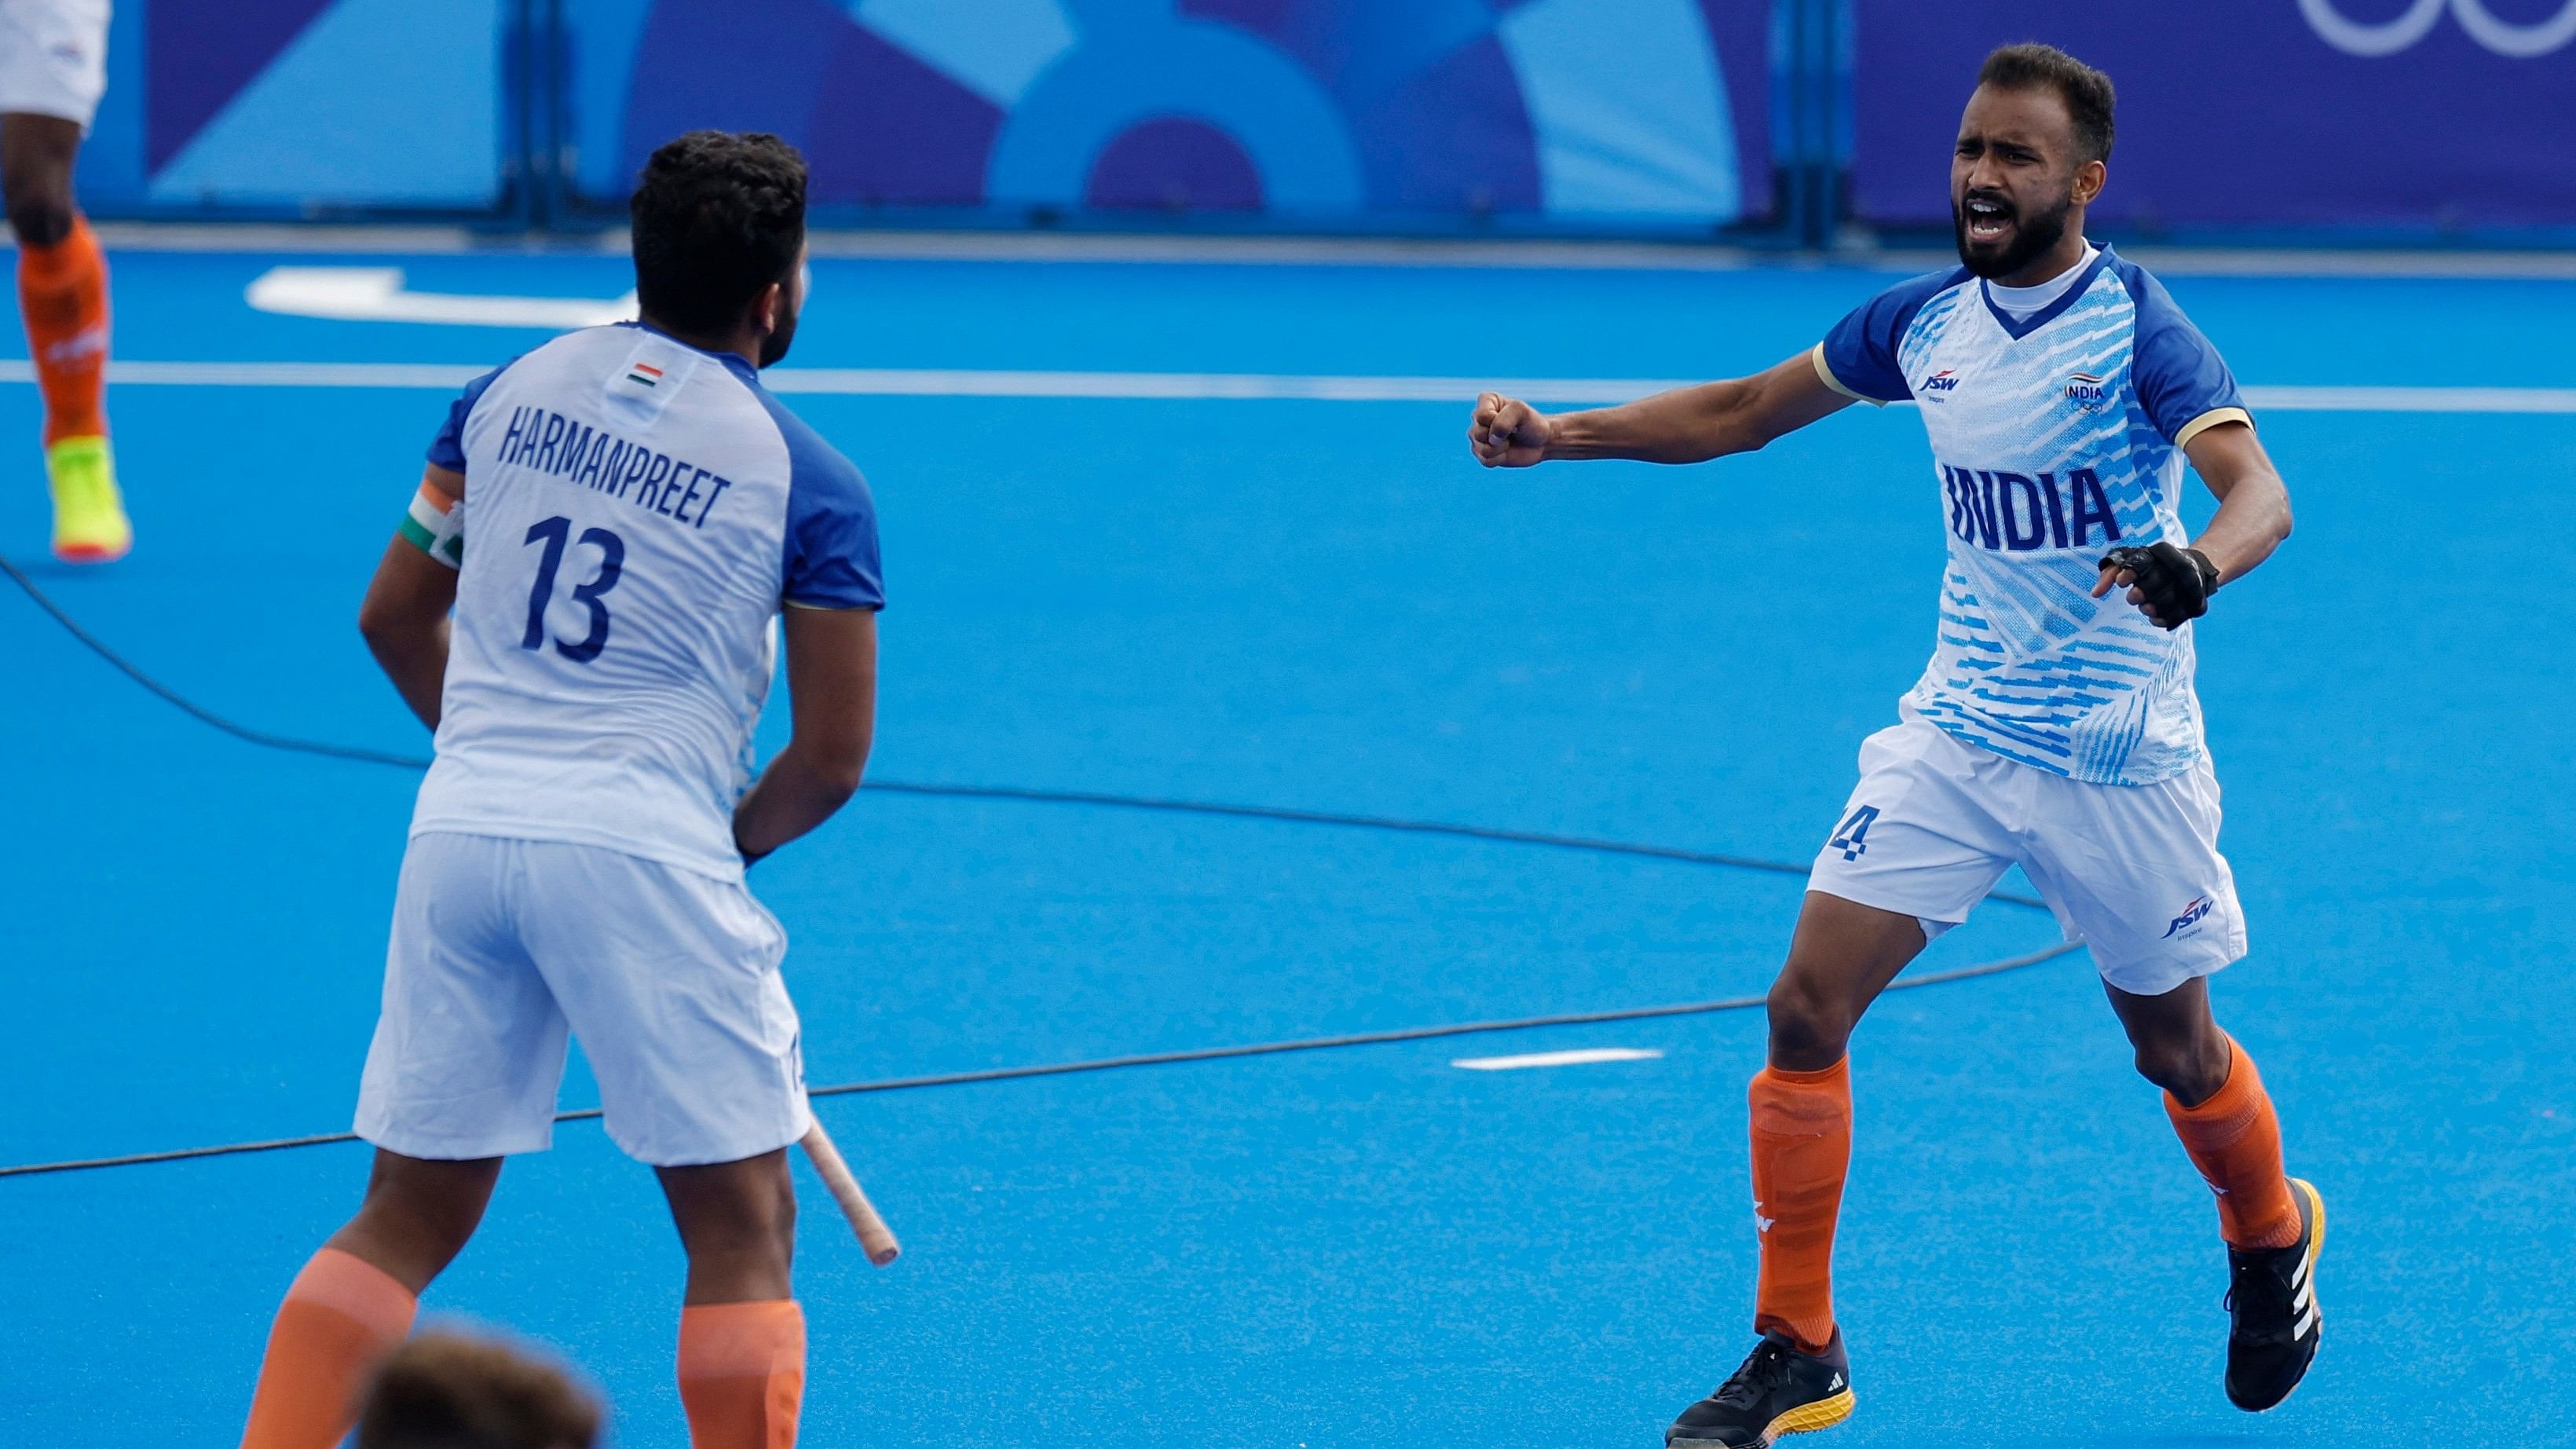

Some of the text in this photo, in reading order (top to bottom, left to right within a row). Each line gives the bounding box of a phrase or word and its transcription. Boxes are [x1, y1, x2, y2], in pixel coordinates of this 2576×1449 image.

[1919, 375, 1959, 391] JSW
[2064, 386, 2105, 400] INDIA
[497, 406, 731, 529] HARMANPREET
[1943, 465, 2122, 551] INDIA
[521, 515, 624, 664] 13
[2161, 900, 2214, 939] JSW
